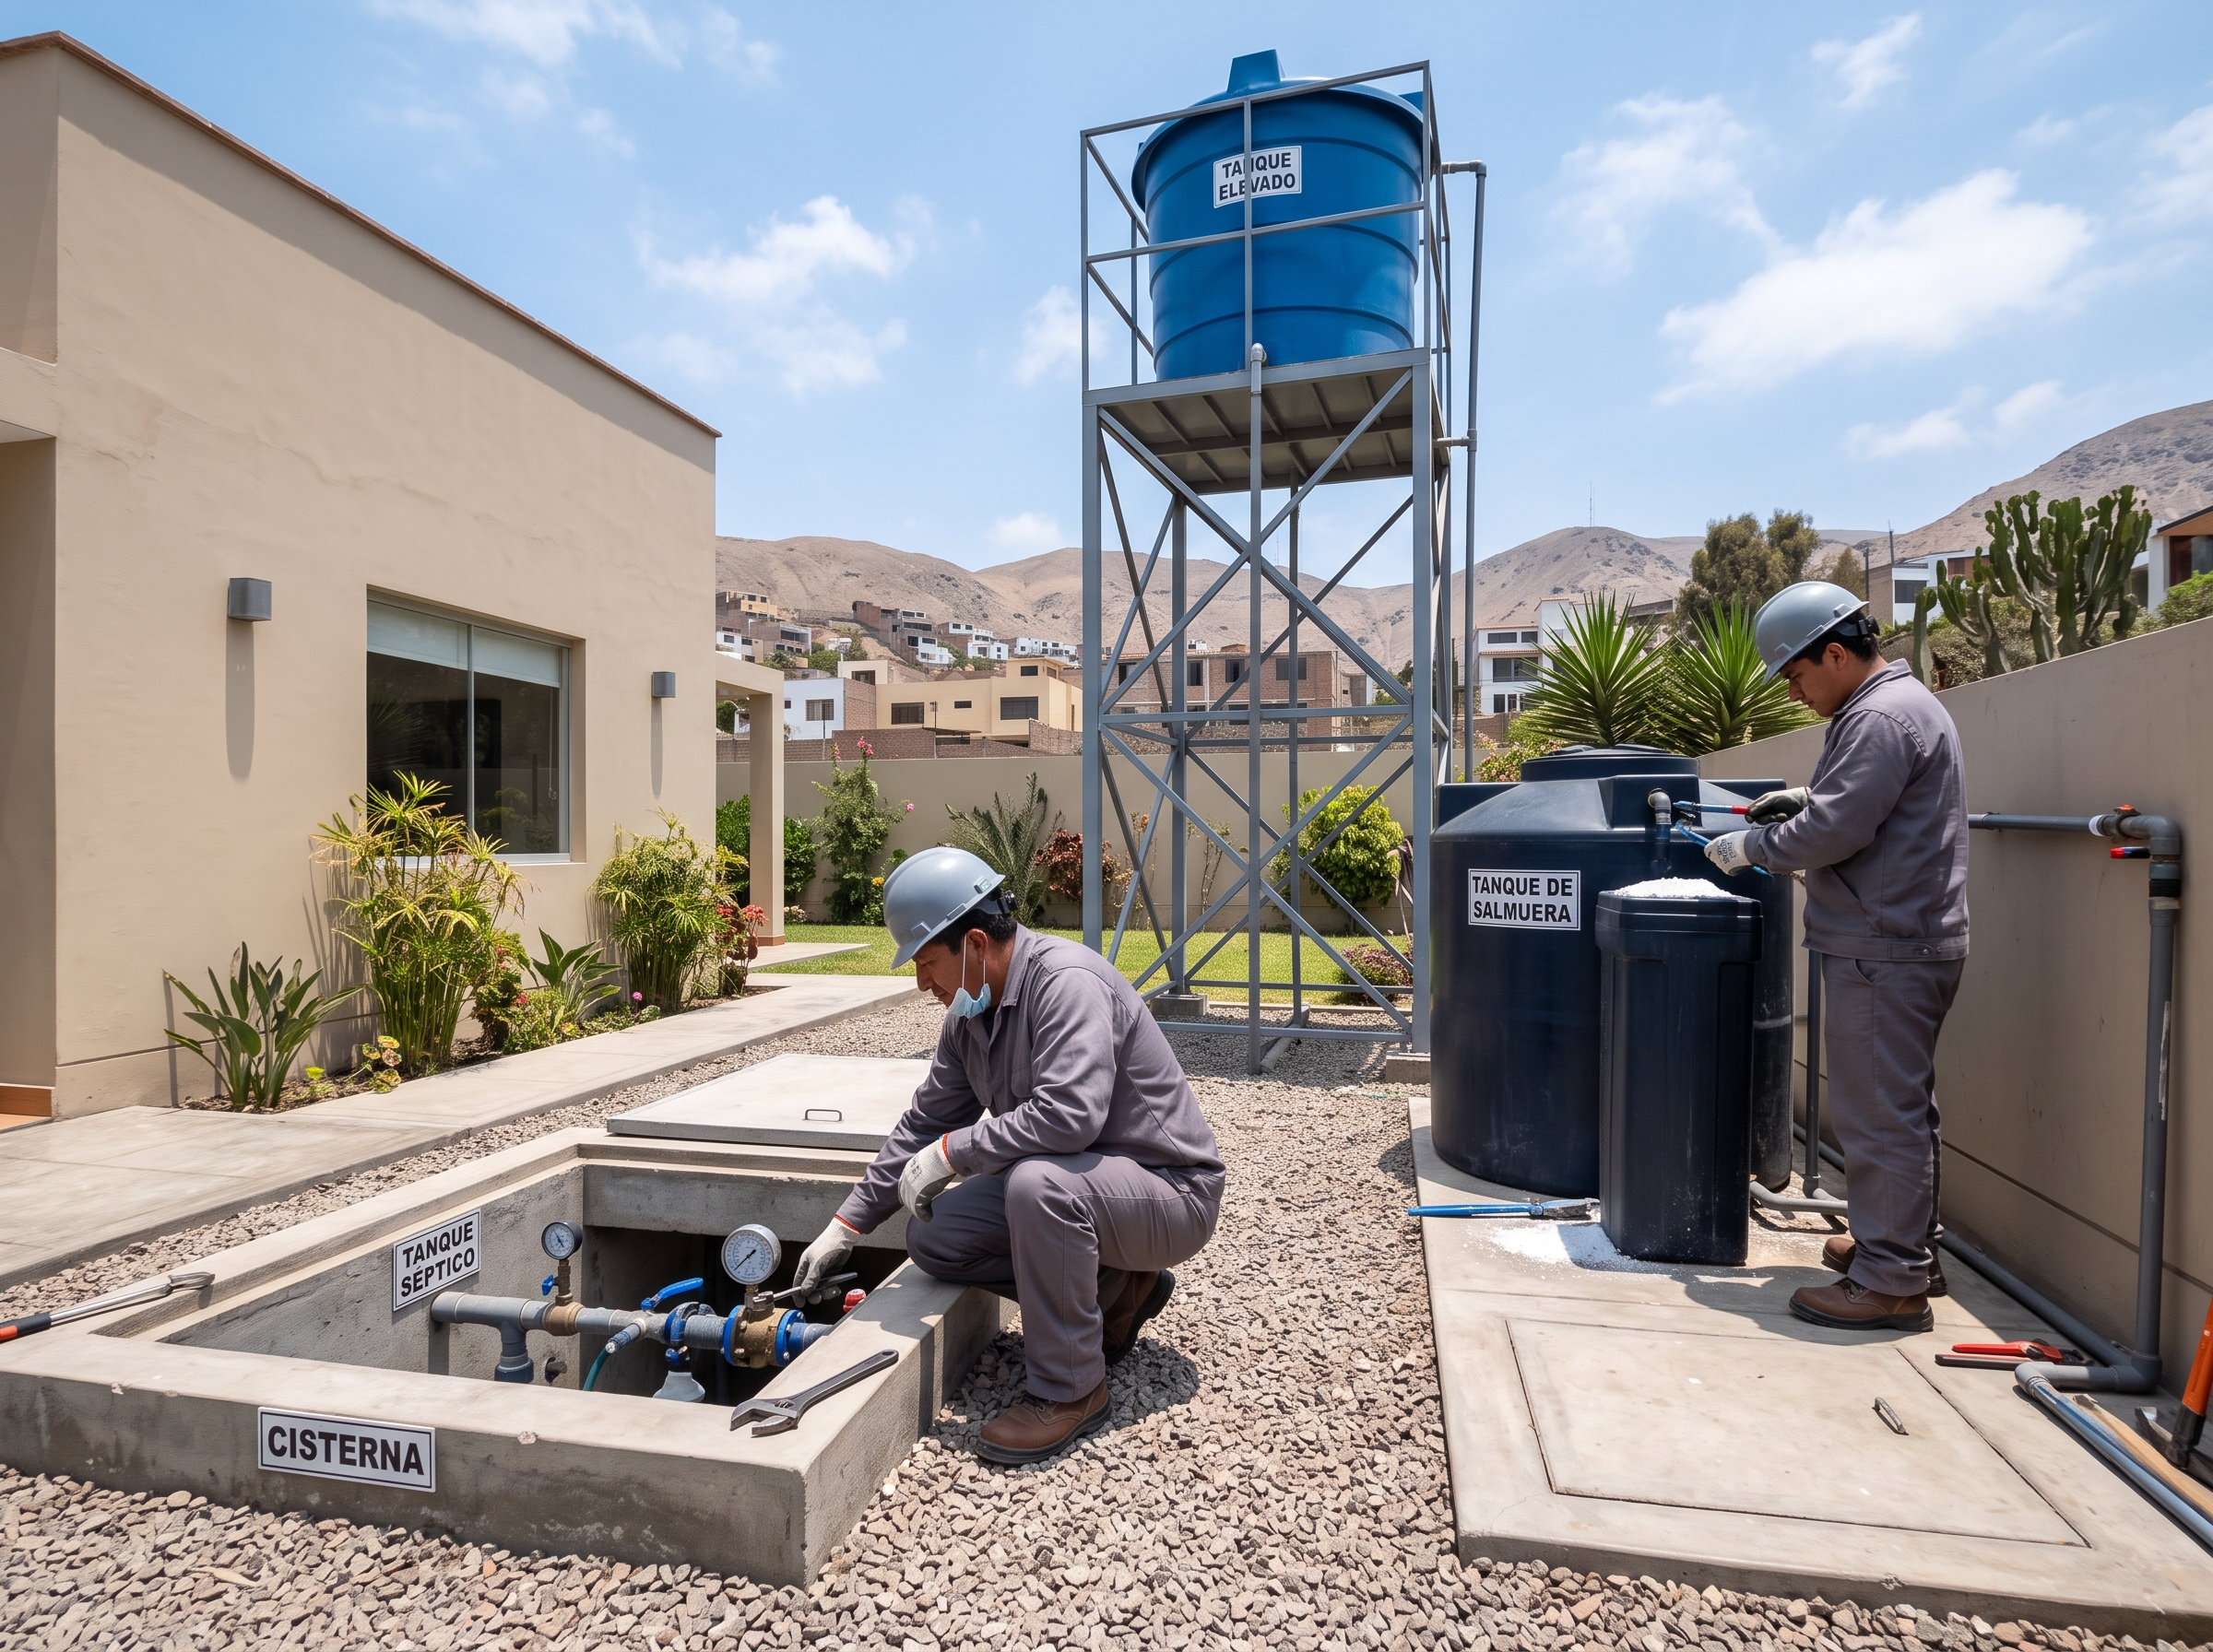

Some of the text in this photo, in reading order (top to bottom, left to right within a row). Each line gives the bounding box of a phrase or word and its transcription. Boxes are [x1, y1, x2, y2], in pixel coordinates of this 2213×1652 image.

[1219, 172, 1296, 201] ELEVADO
[1473, 876, 1573, 897] TANQUE DE
[1473, 901, 1572, 923] SALMUERA
[402, 1221, 473, 1268] TANQUE
[401, 1247, 475, 1297] SÉPTICO
[267, 1425, 425, 1476] CISTERNA
